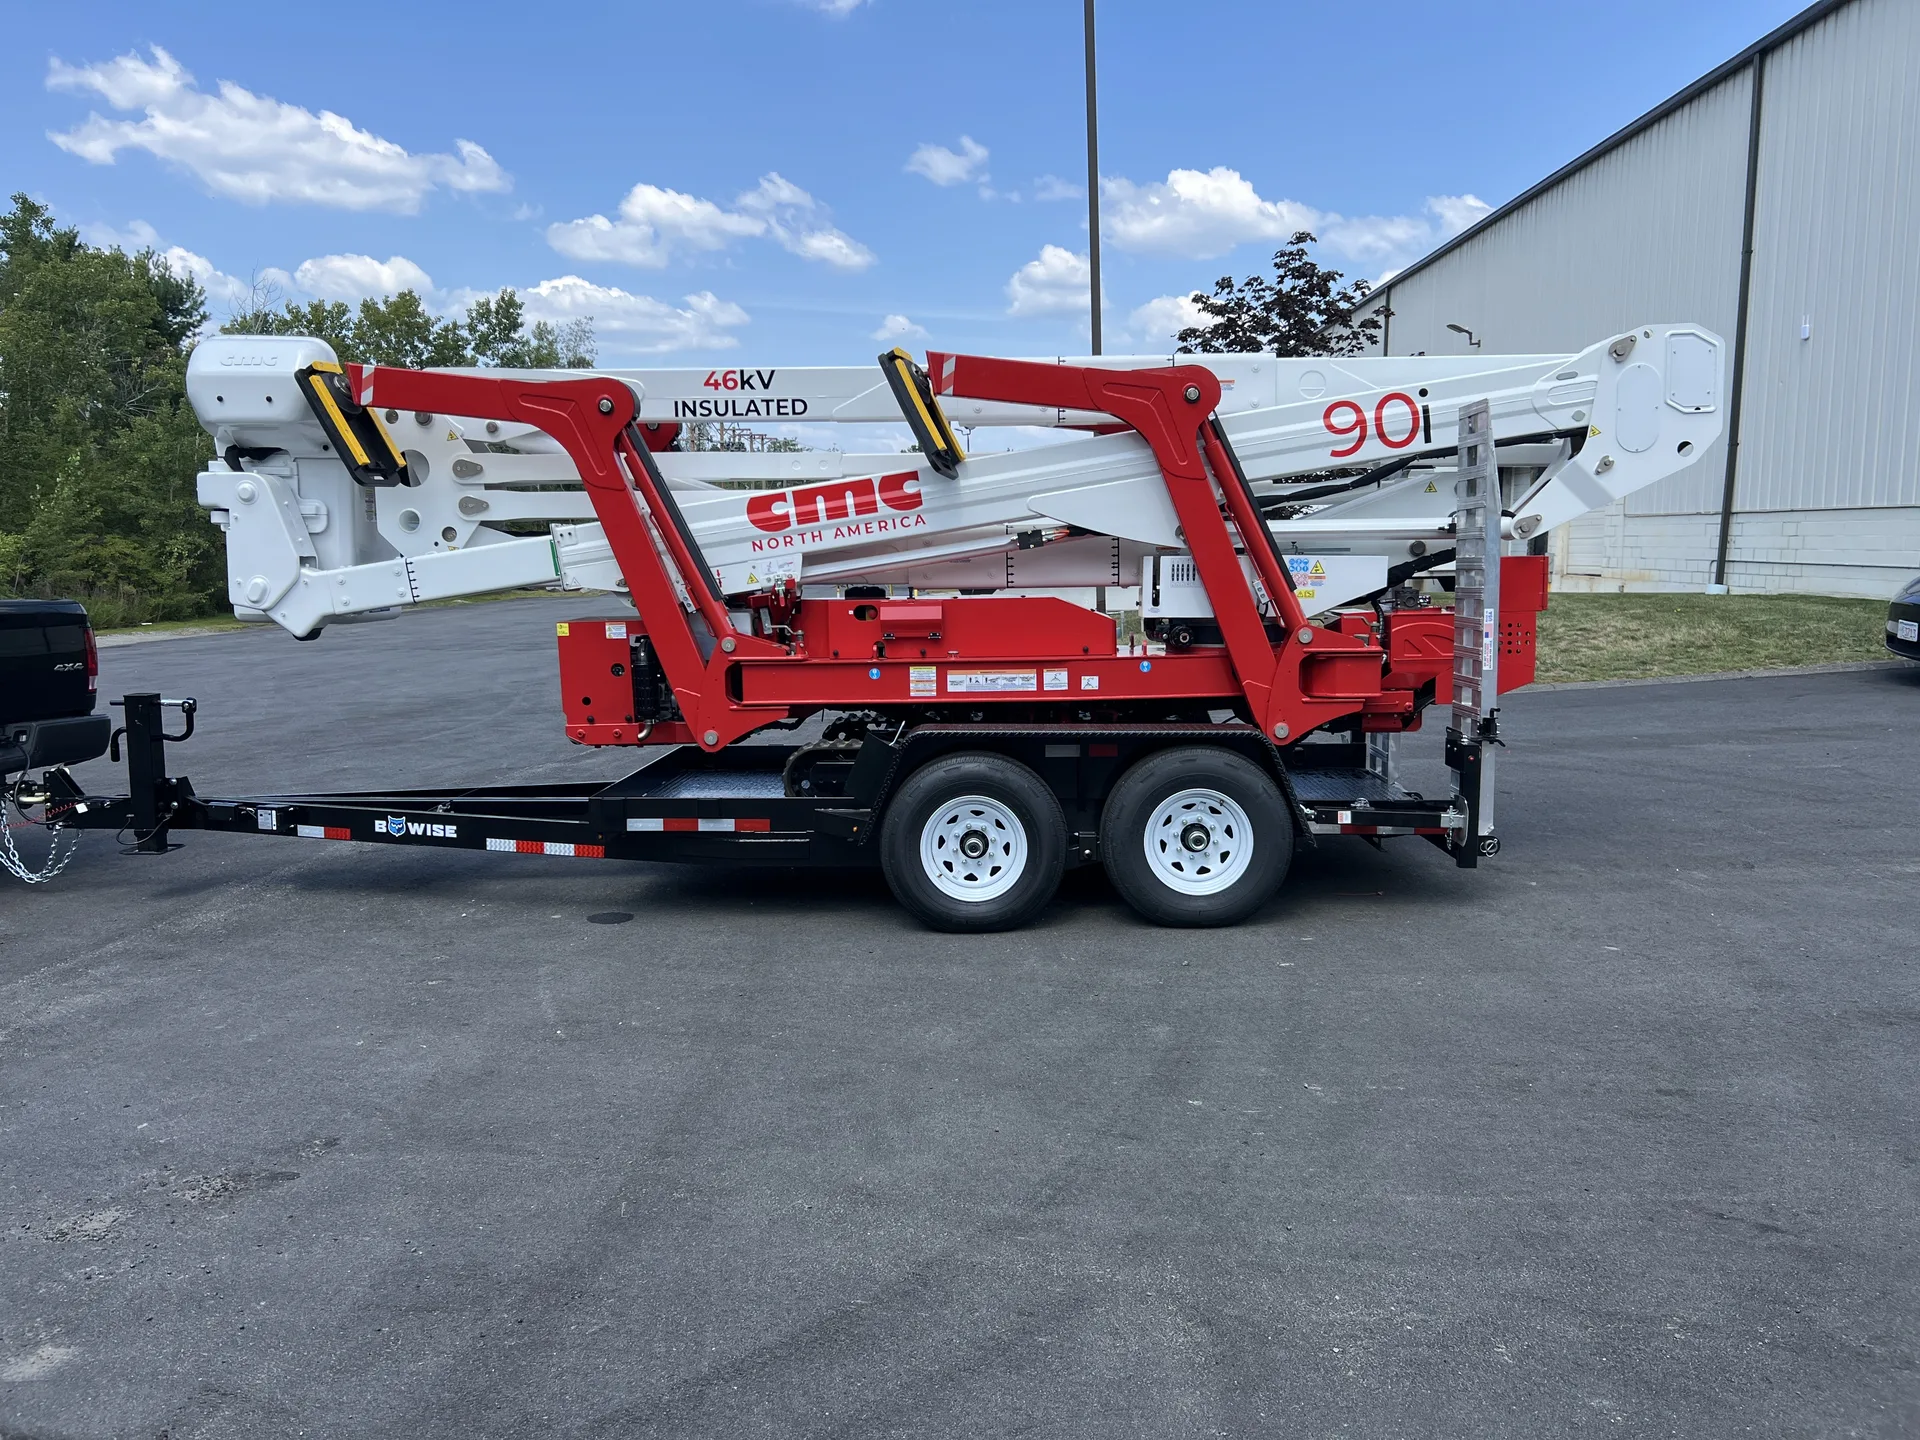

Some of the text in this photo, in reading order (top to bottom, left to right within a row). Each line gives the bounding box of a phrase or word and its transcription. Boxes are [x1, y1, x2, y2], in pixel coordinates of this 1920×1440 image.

[703, 369, 776, 391] 46kV
[674, 398, 808, 418] INSULATED
[1322, 387, 1432, 458] 90i
[751, 514, 927, 552] NORTH AMERICA
